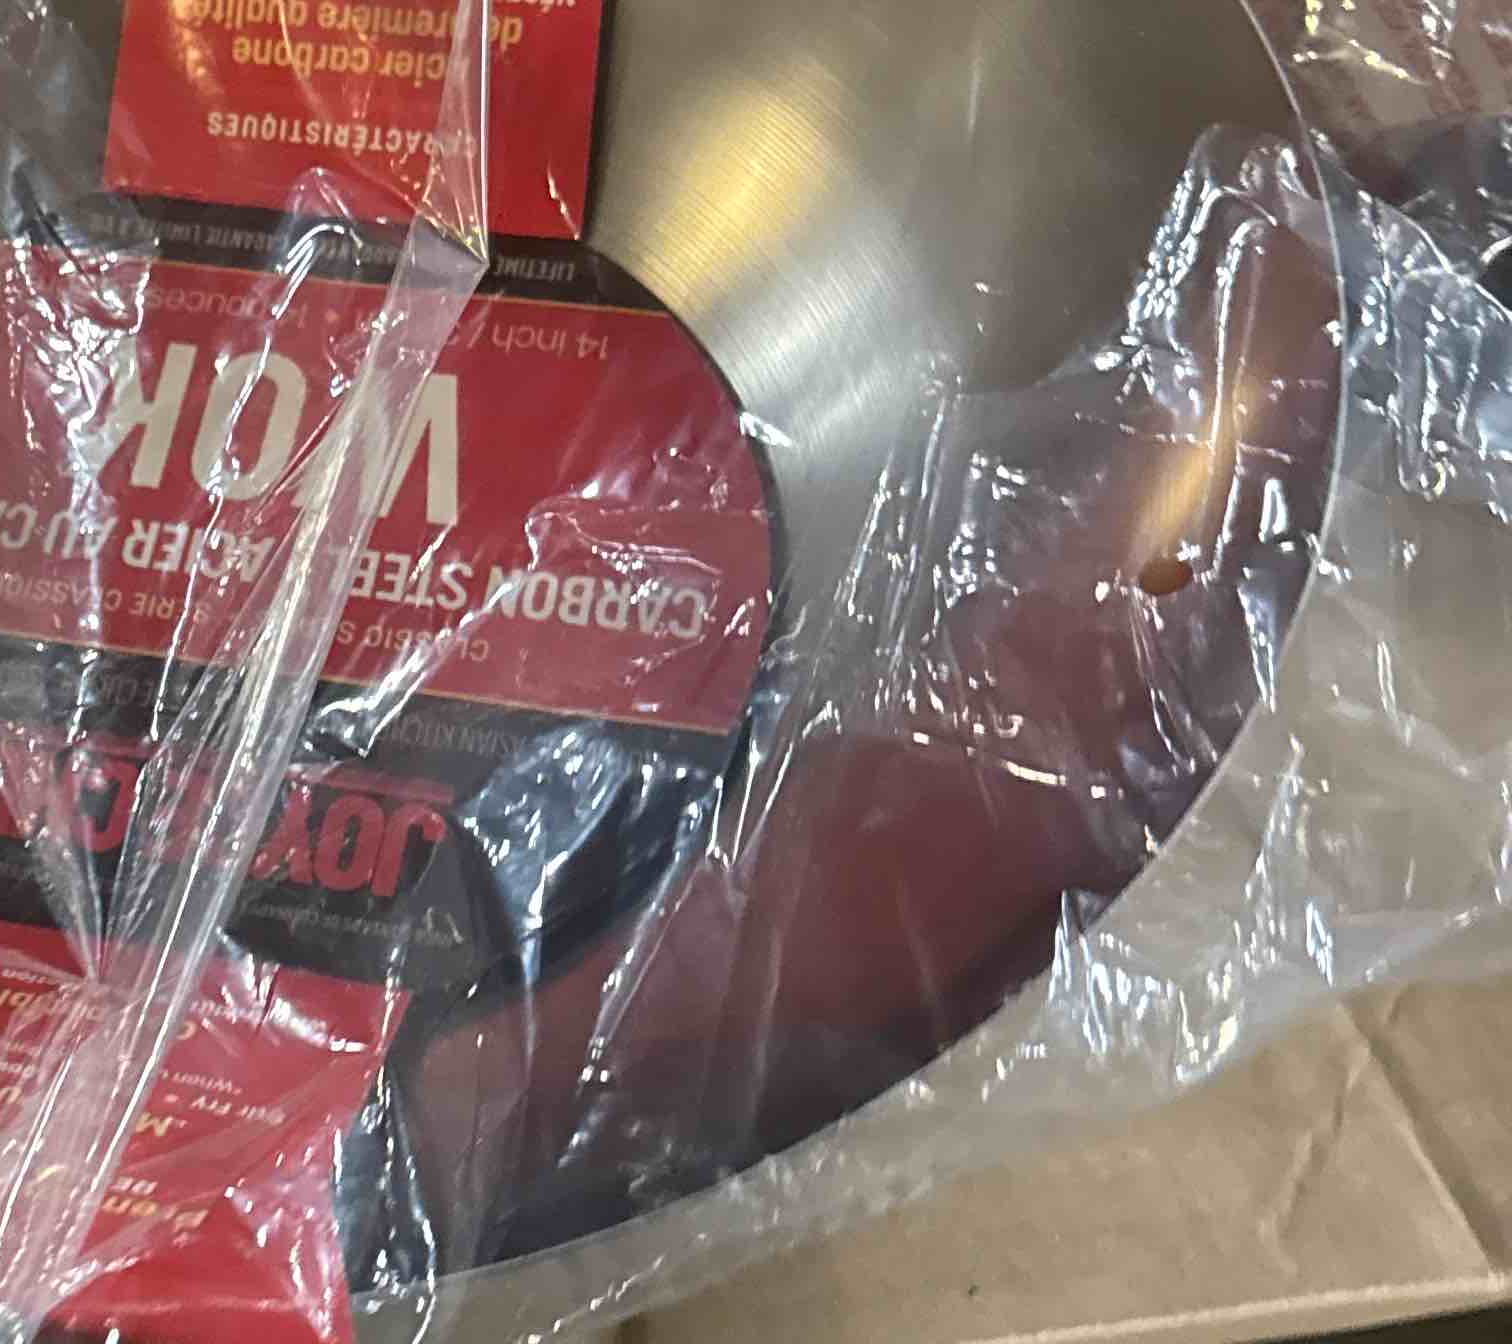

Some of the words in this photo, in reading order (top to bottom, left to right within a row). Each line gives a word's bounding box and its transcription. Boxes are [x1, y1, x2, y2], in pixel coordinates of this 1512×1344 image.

[231, 35, 370, 80] carbone
[491, 322, 568, 358] inch
[575, 331, 610, 360] 14
[100, 333, 459, 528] WOK
[121, 516, 276, 583] ACIER
[128, 591, 208, 625] SRIE
[488, 567, 706, 640] CARBON
[162, 763, 448, 898] JOY
[188, 1094, 233, 1117] Fry
